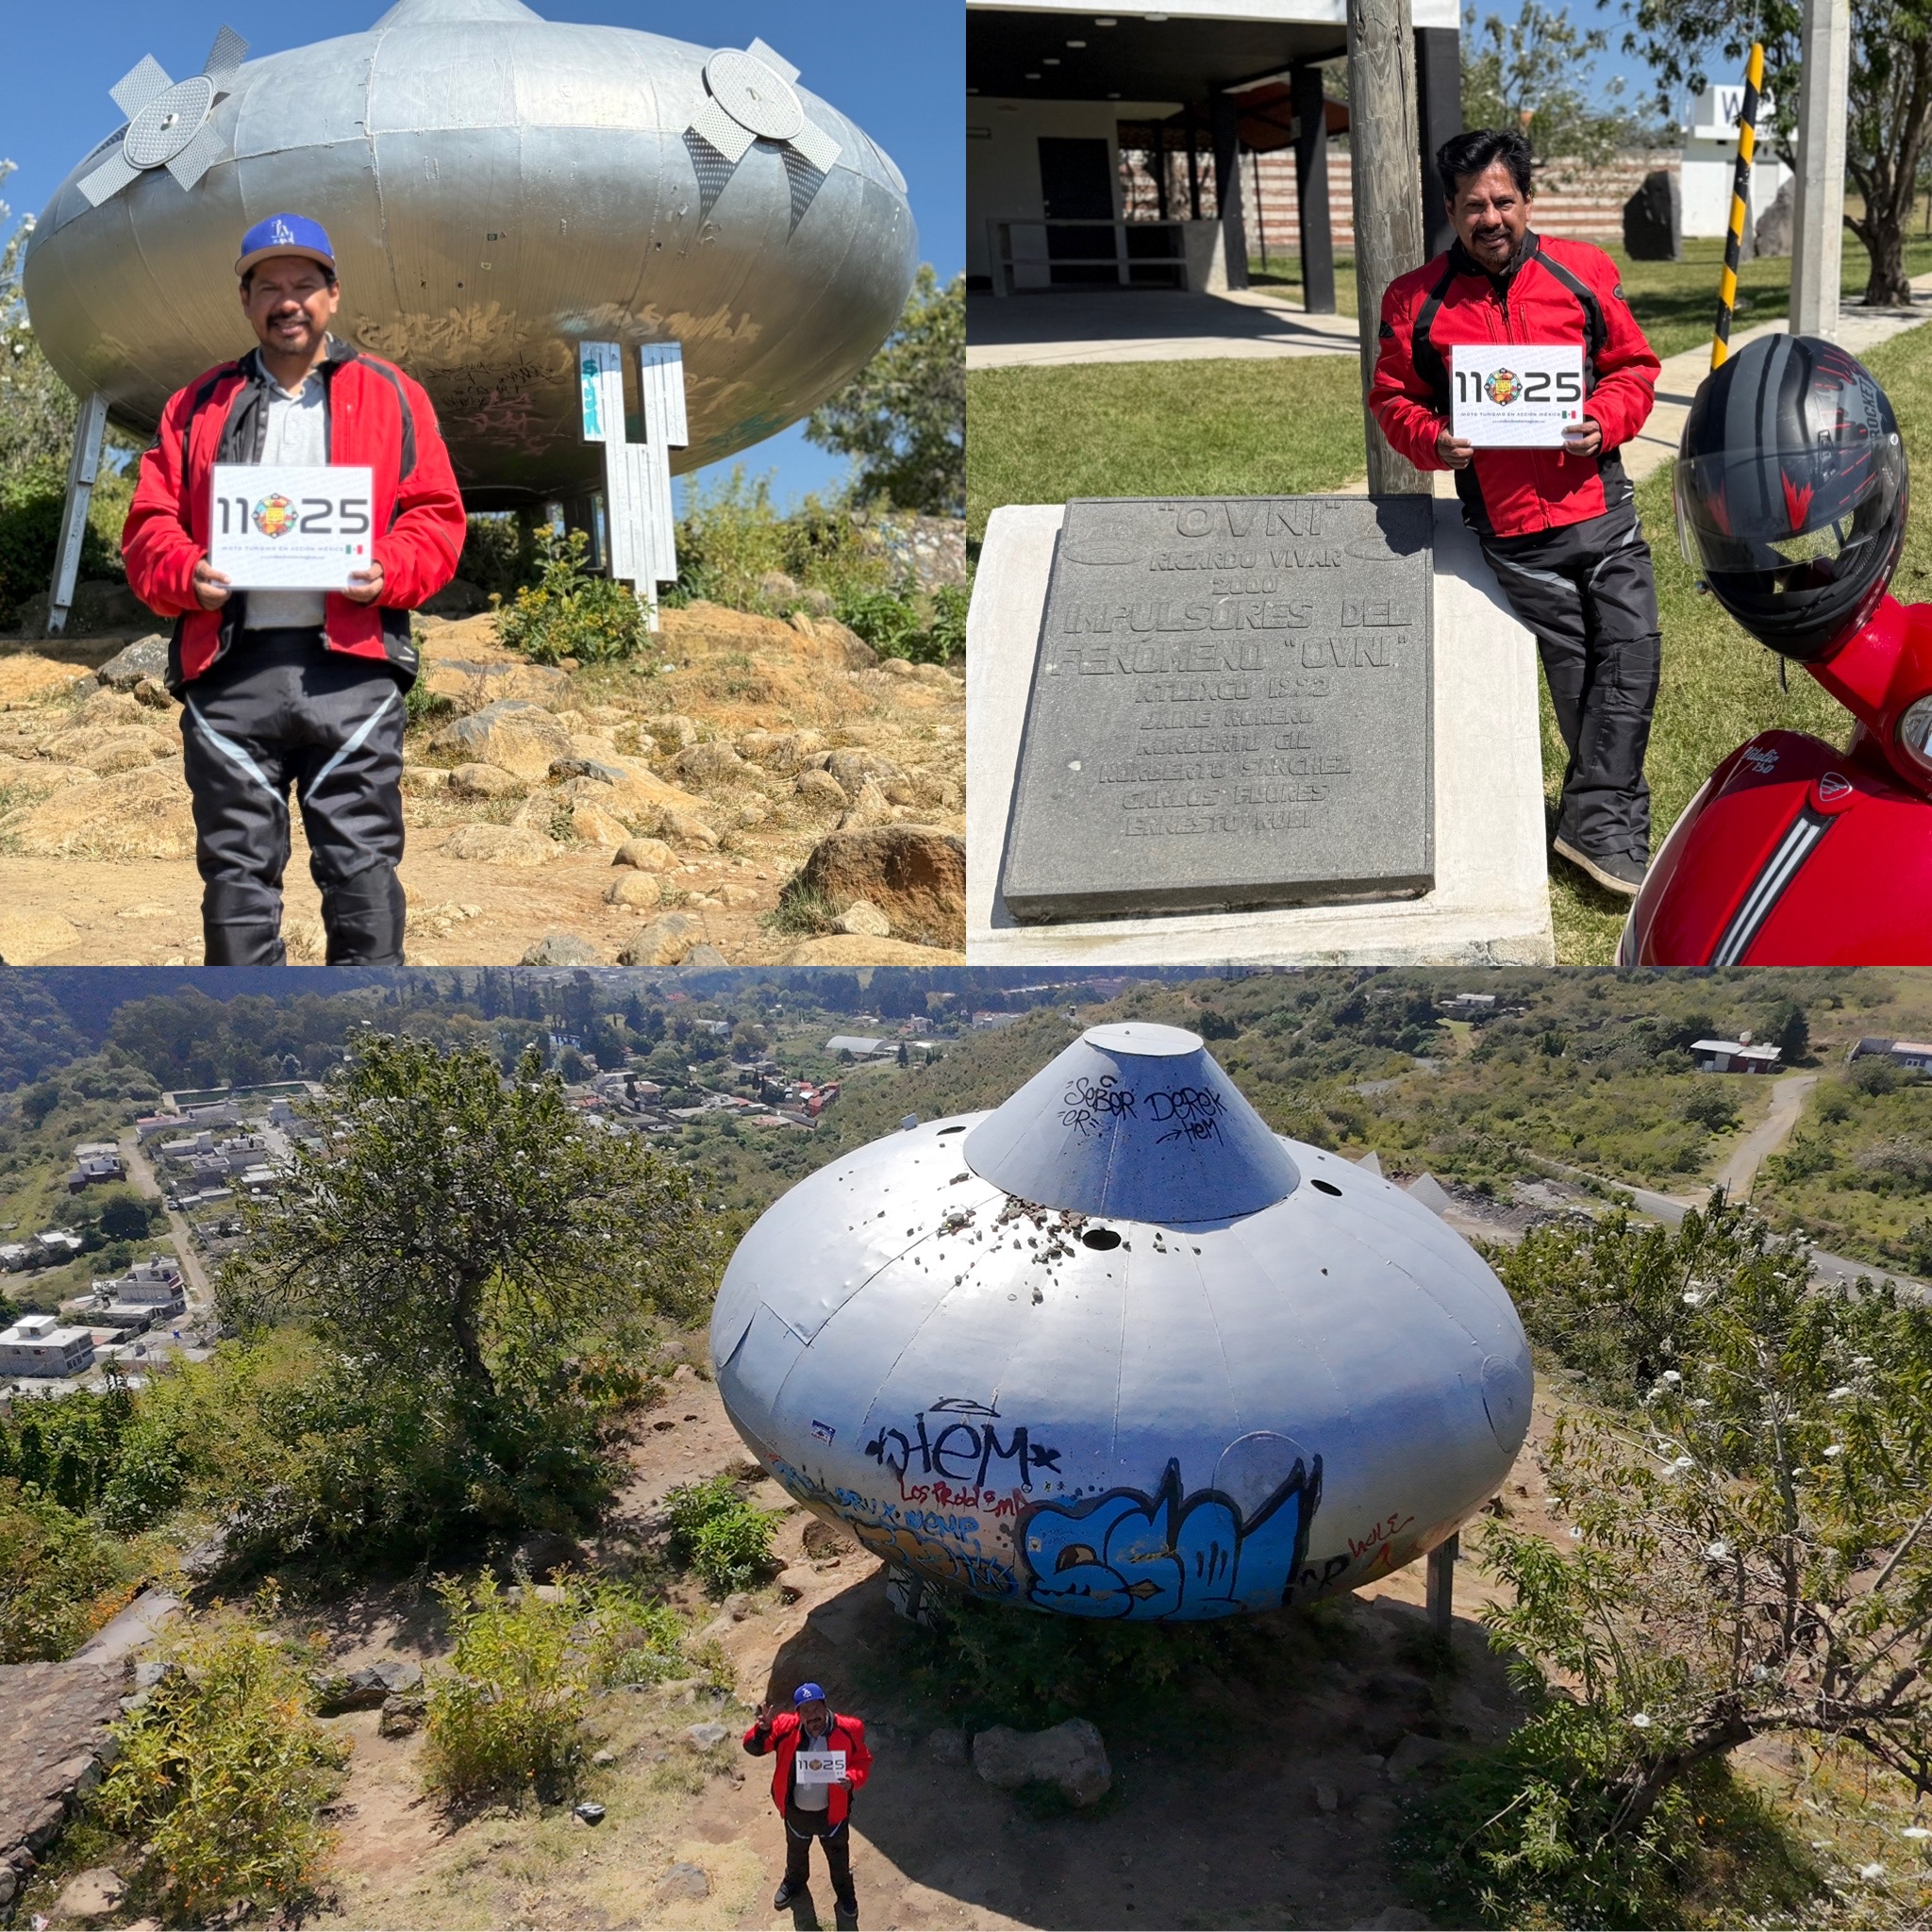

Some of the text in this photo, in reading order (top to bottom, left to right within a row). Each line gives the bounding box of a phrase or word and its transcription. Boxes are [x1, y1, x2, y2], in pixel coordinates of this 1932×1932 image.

[1149, 549, 1341, 572] RICARDO VIVAR
[1211, 575, 1278, 595] 2000
[1063, 598, 1413, 634] IMPULSORES DEL
[1135, 680, 1252, 704] ATLIXCO
